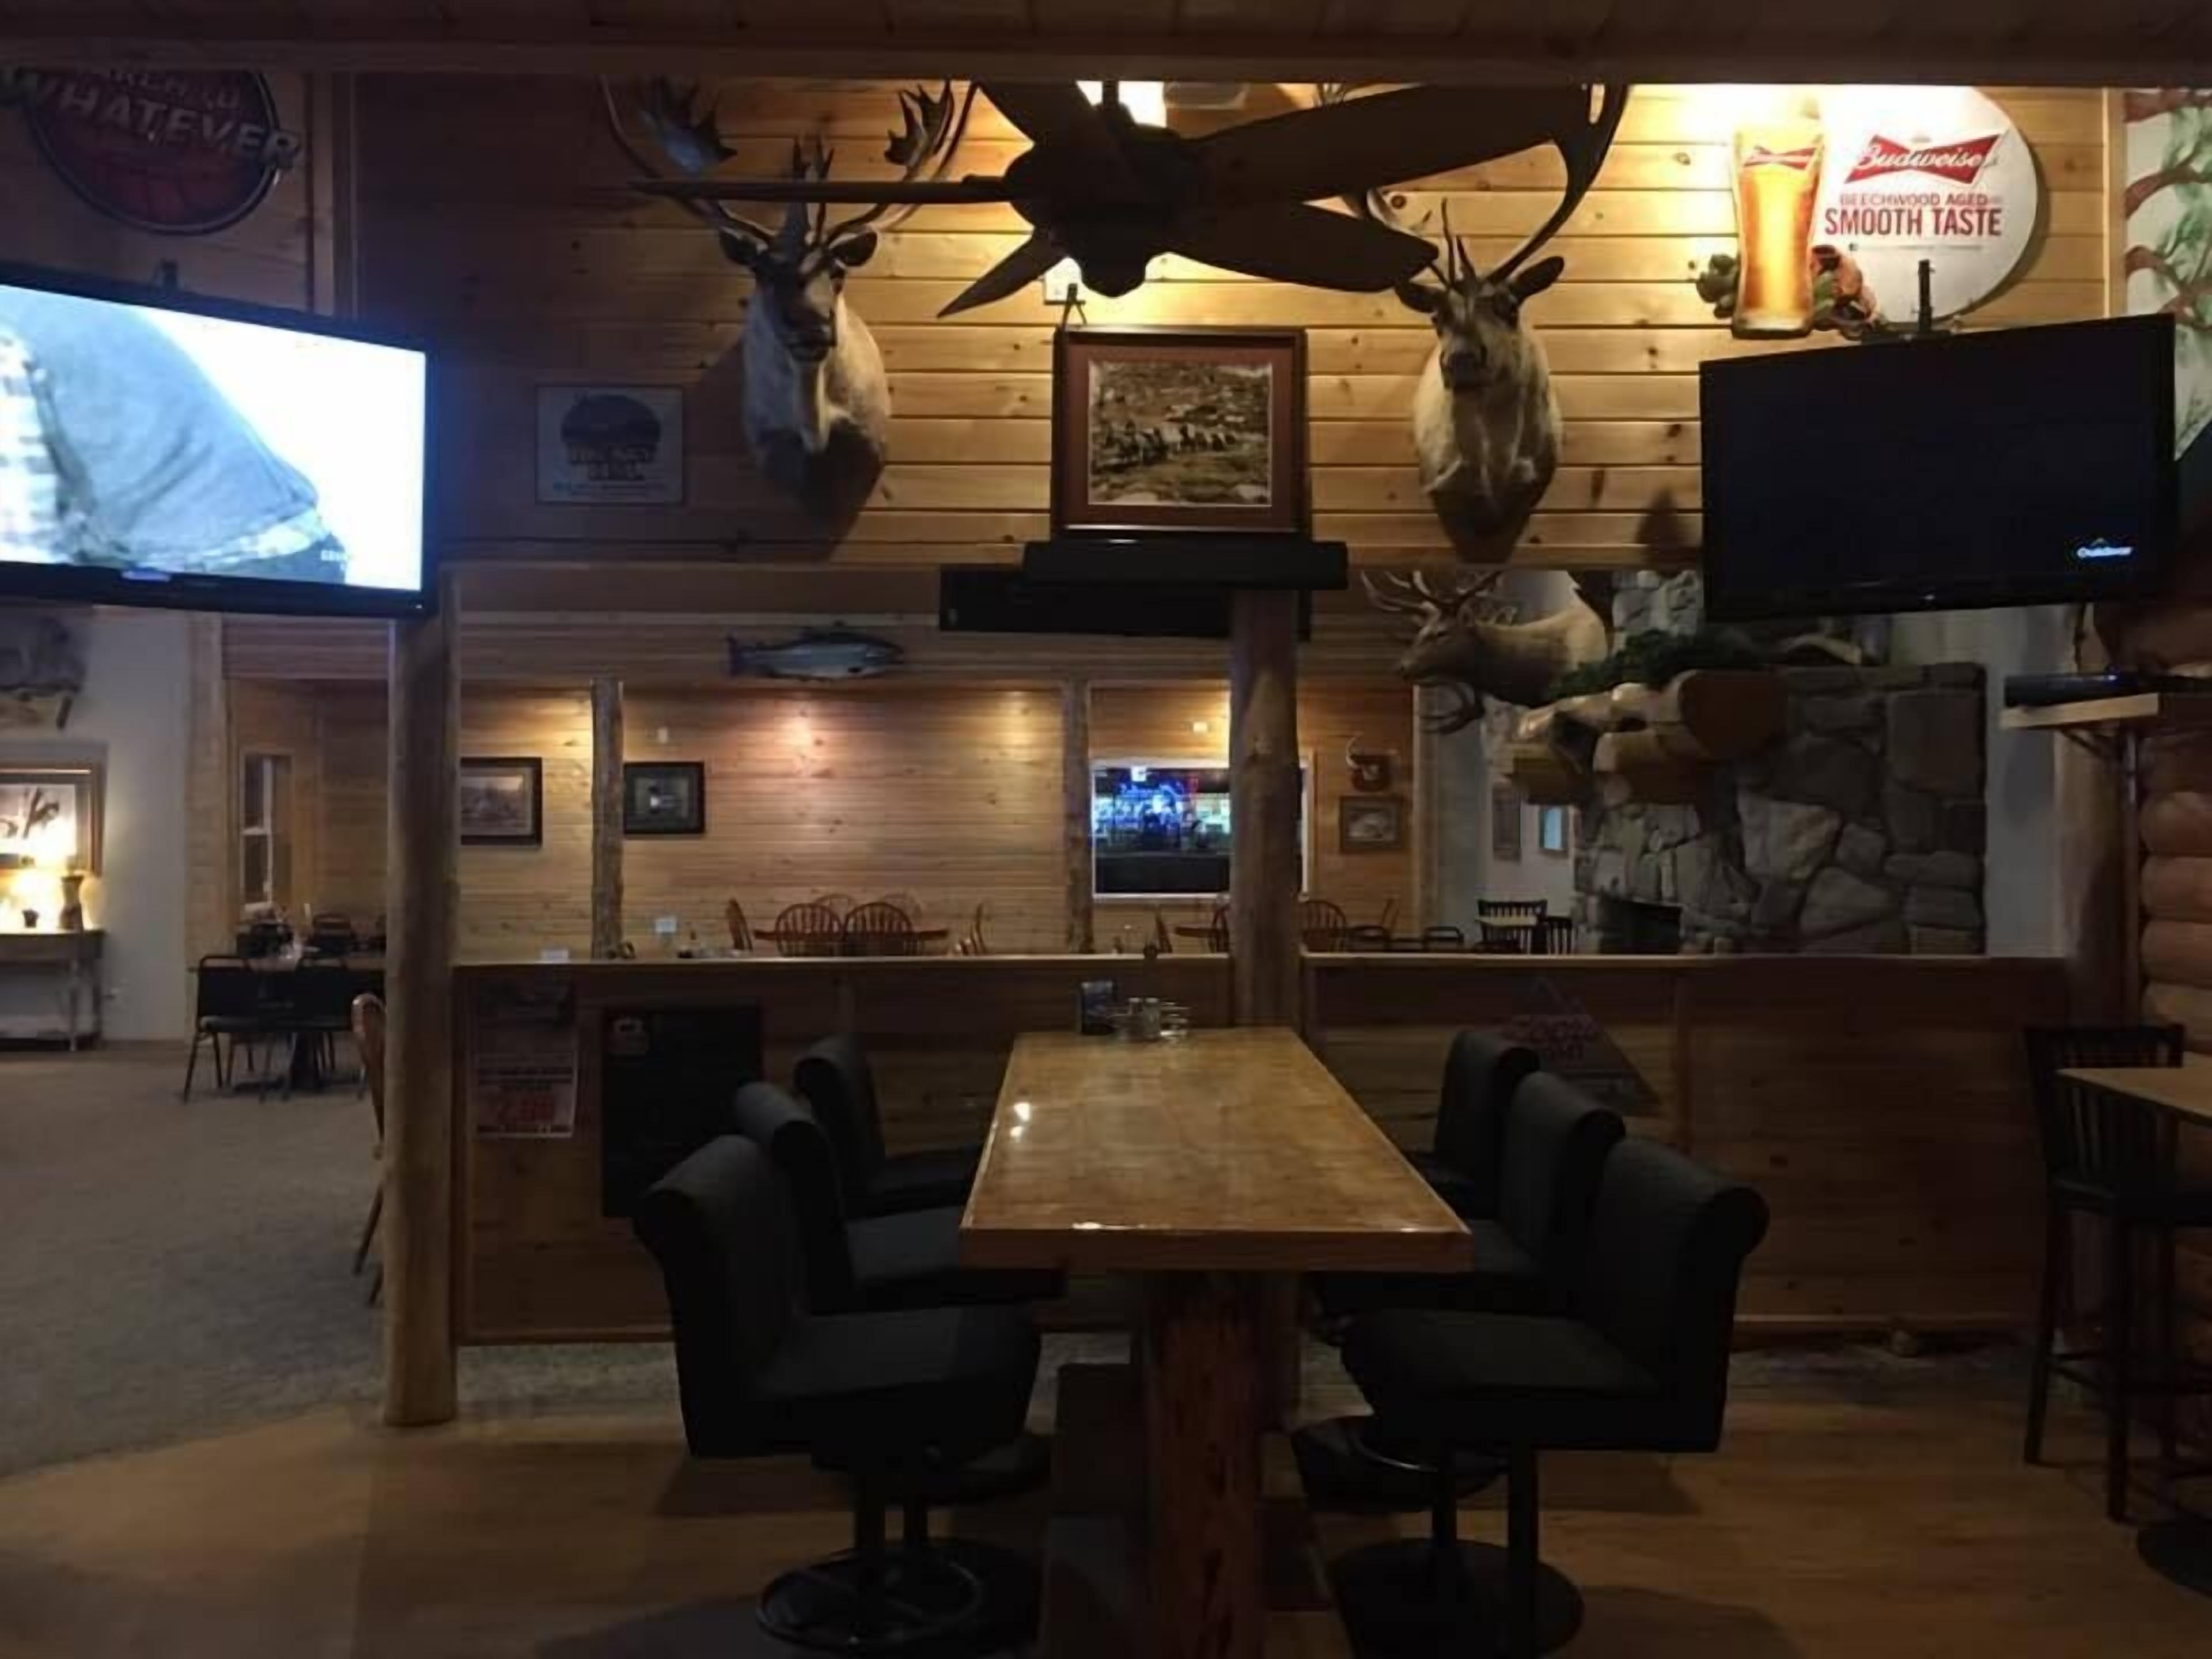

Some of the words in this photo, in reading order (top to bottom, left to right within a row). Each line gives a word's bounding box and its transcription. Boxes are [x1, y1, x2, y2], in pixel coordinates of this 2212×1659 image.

[1839, 193, 1940, 207] BEECHWOOD
[1945, 193, 1989, 206] AGED
[1824, 208, 1922, 236] SMOOTH
[1933, 208, 2002, 236] TASTE
